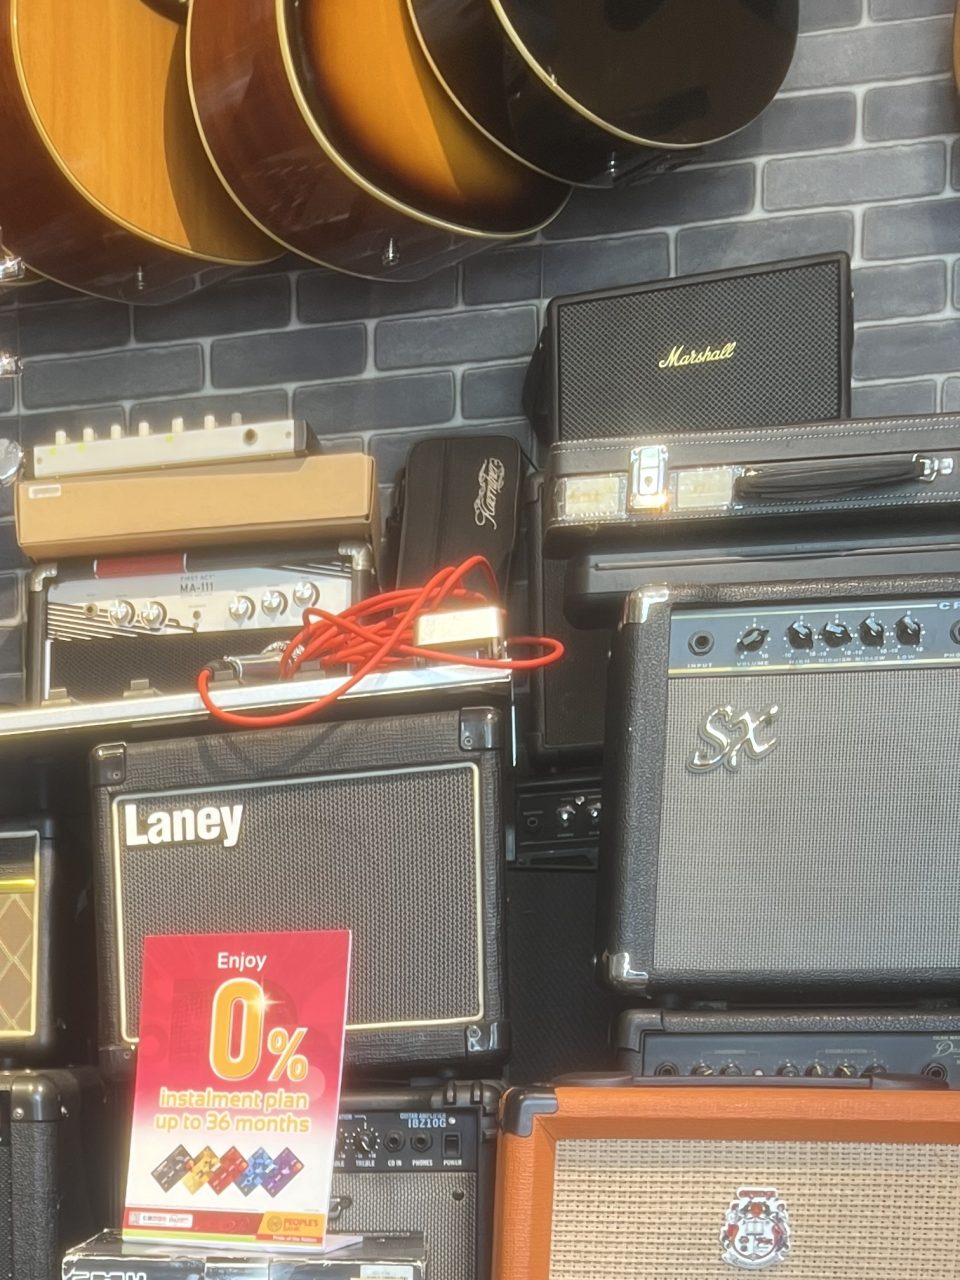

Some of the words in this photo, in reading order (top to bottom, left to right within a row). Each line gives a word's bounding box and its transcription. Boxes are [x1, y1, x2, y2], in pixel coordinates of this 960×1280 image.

[659, 341, 737, 368] Marshall
[180, 581, 214, 593] MA-111
[687, 704, 779, 773] SX
[124, 802, 244, 848] Laney
[217, 951, 267, 972] Enjoy
[209, 977, 309, 1082] 0%
[159, 1086, 261, 1109] instalment
[263, 1088, 309, 1112] plan
[154, 1114, 179, 1132] up
[182, 1112, 202, 1131] to
[206, 1112, 230, 1131] 36
[235, 1113, 310, 1133] months
[408, 1118, 447, 1128] IBZ10G
